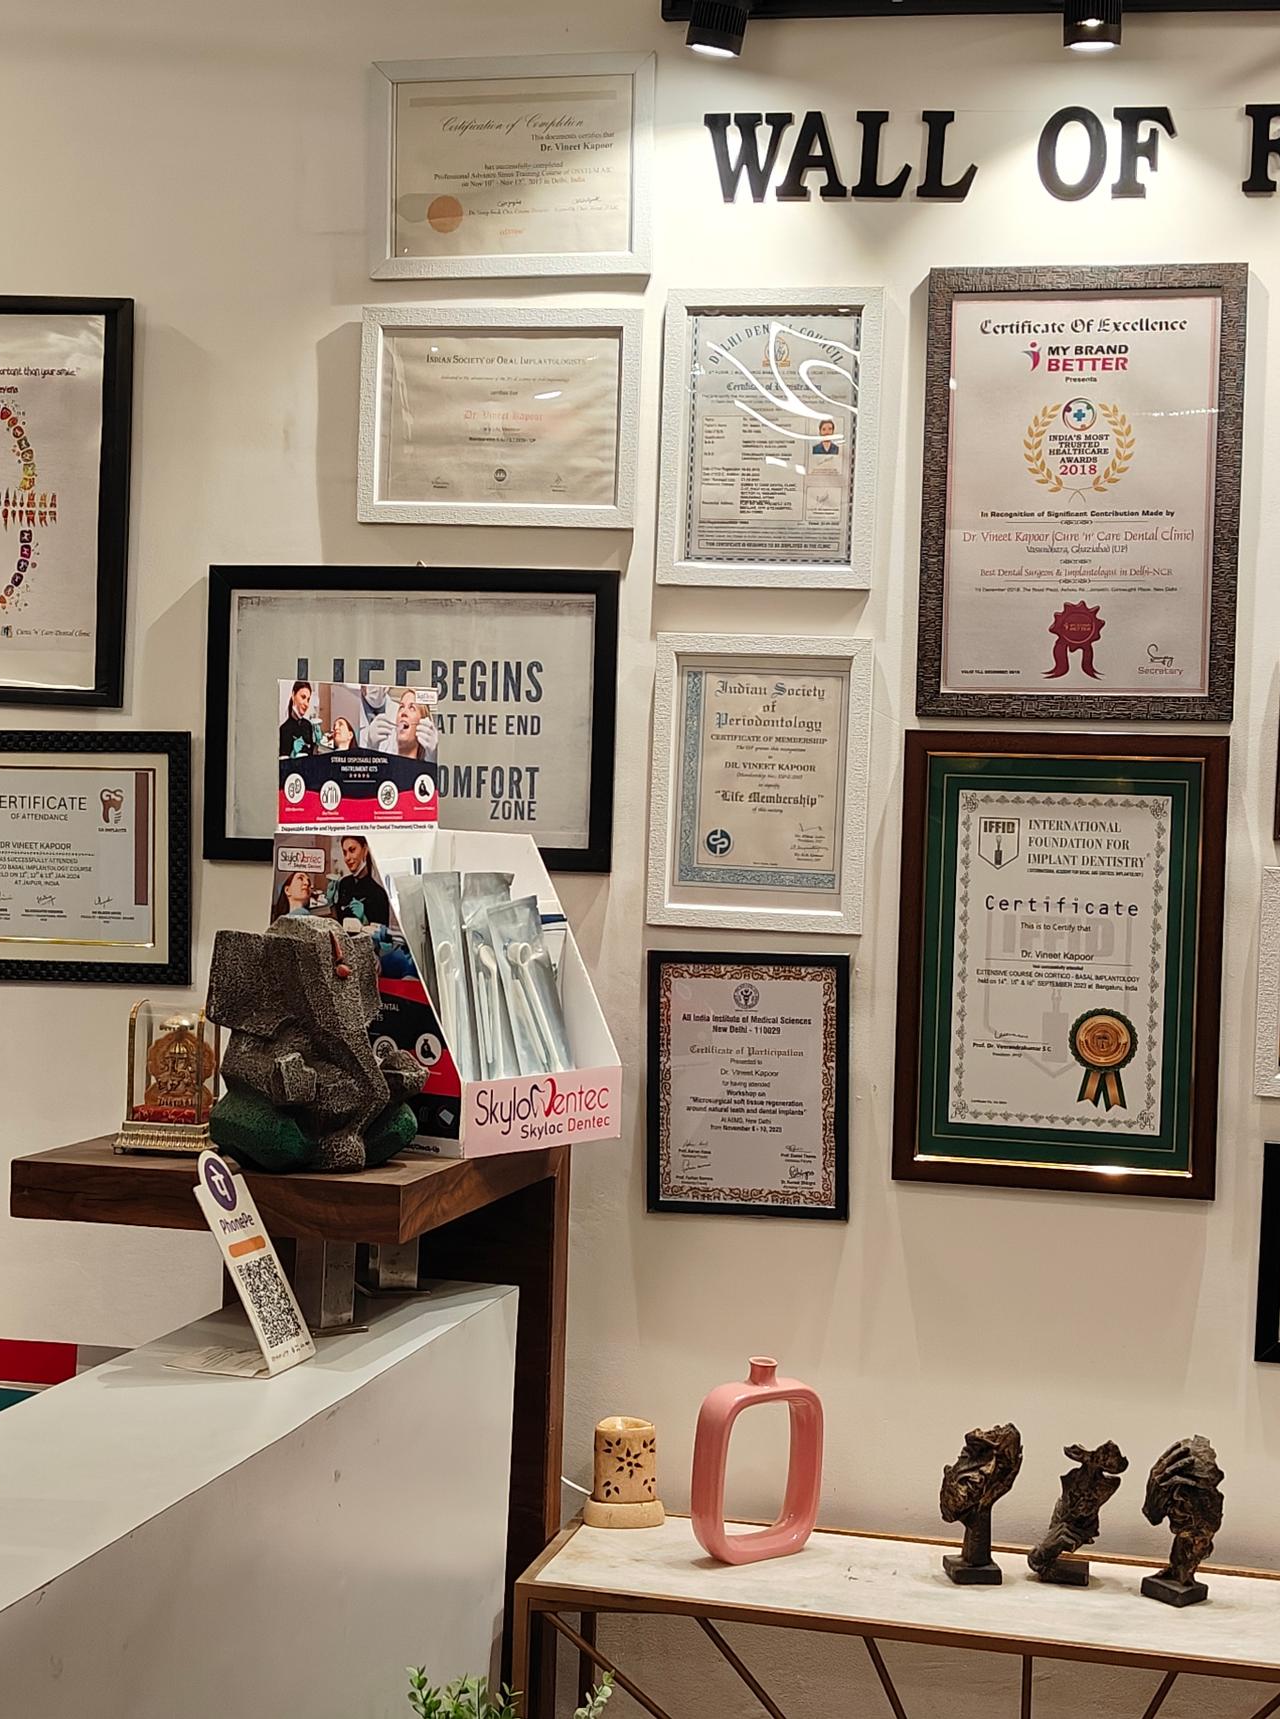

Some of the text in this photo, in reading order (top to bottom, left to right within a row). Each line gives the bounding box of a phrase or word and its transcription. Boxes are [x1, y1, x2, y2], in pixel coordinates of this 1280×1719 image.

[554, 143, 580, 151] Vineet
[583, 142, 613, 150] Kapoor
[703, 110, 980, 203] WALL
[1037, 105, 1177, 201] OF
[980, 317, 1187, 336] Certificate Of Excellence
[1047, 344, 1129, 356] MY BRAND
[453, 355, 485, 364] SOCIETY
[1047, 357, 1129, 372] BETTER
[24, 366, 40, 376] than
[1084, 433, 1110, 441] MOST
[1059, 456, 1097, 464] AWARDS
[1059, 464, 1098, 476] 2018
[1047, 510, 1088, 518] Significant
[963, 532, 977, 542] Dr
[981, 532, 1012, 542] Vineet
[1015, 531, 1050, 544] Kapoor
[1125, 528, 1159, 541] Dental
[1161, 526, 1194, 542] Clinic)
[980, 566, 1023, 577] Best Dental
[1138, 666, 1184, 677] Secretary
[432, 659, 544, 702] BEGINS
[771, 682, 825, 699] Society
[763, 700, 777, 713] of
[437, 714, 541, 736] AT THE END
[716, 712, 822, 732] Periodontology
[711, 733, 828, 745] CERTIFICATE MEMBERSHIP
[742, 761, 816, 772] VINEET KAPOOR
[438, 765, 540, 800] OMFORT
[490, 800, 536, 821] ZONE
[983, 821, 1015, 834] IFFID
[1028, 819, 1122, 833] INTERNATIONAL
[40, 842, 71, 850] KAPOOR
[1028, 837, 1130, 850] FOUNDATION FOR
[1027, 854, 1145, 868] IMPLANT DENTISTRY
[985, 895, 1139, 917] Certificate
[1052, 923, 1076, 933] Certify
[1021, 950, 1094, 962] Dr. Vineet Kapoor
[1095, 974, 1140, 983] IMPLANTOLOGY
[693, 1014, 812, 1025] India Institute Medical Sciences
[712, 1025, 728, 1033] New
[755, 1069, 779, 1078] Kapoor
[726, 1090, 756, 1098] Workshop
[520, 1116, 610, 1139] Skyloc Dentec
[219, 1212, 255, 1235] PhonePe
